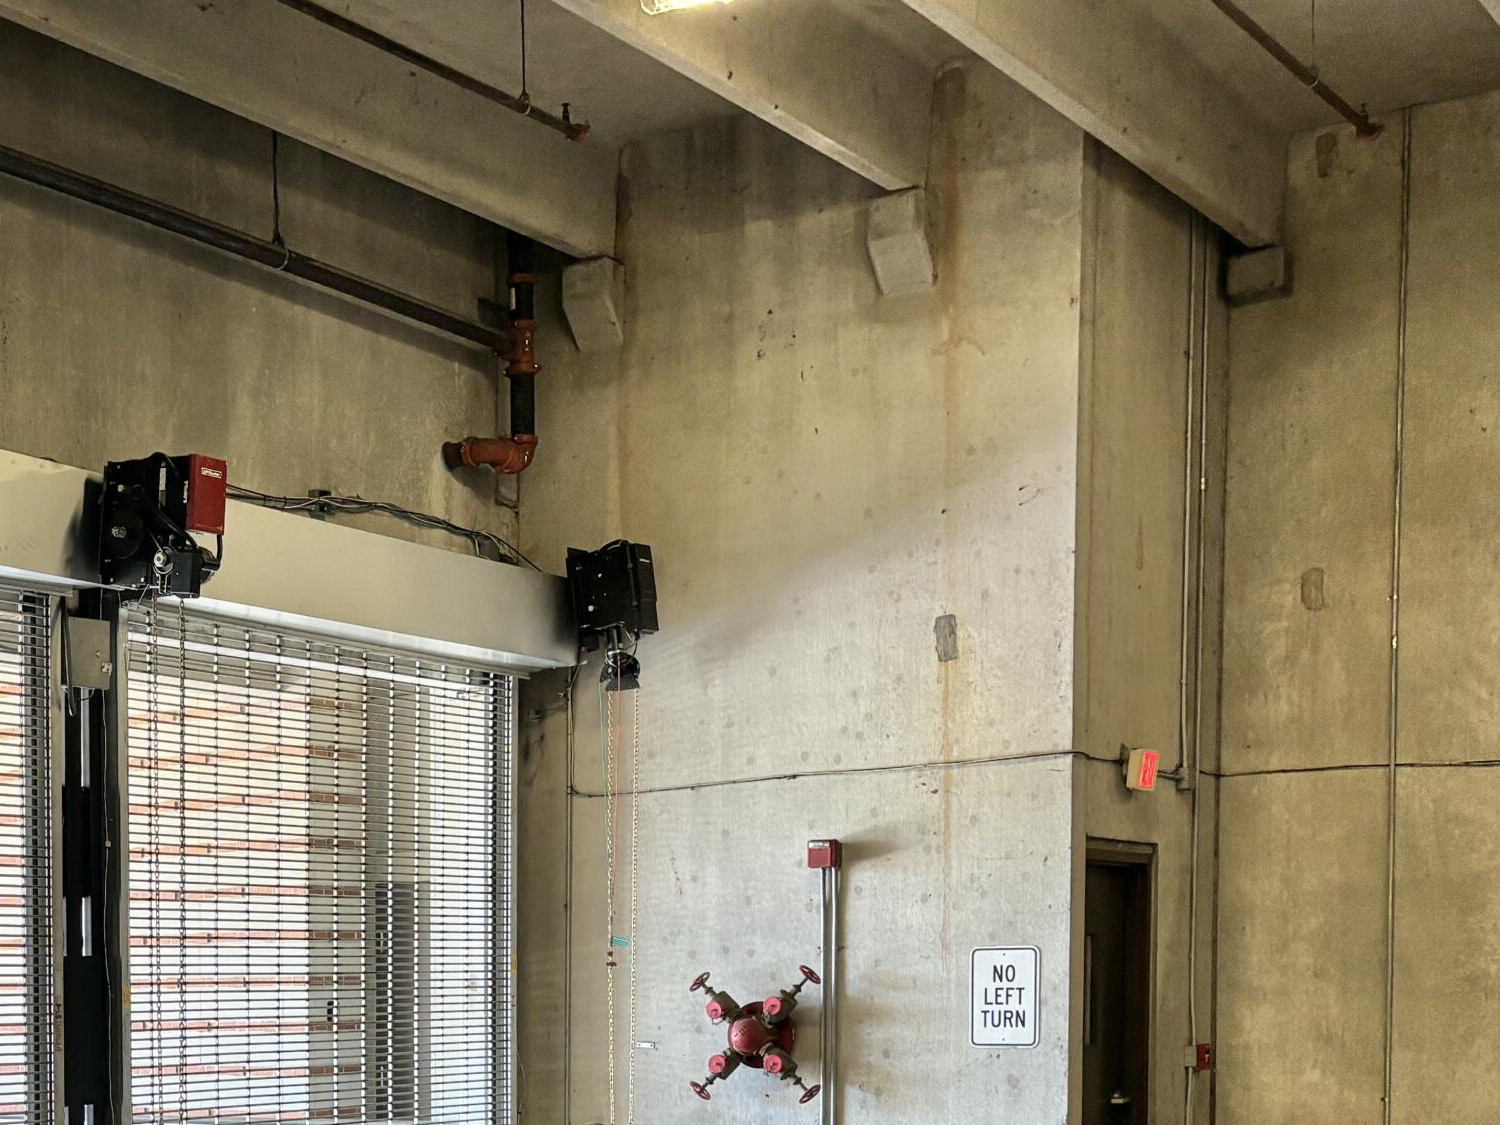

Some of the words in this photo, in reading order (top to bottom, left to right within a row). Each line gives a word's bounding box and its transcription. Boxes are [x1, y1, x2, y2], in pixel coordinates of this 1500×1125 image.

[993, 964, 1016, 983] NO
[984, 987, 1025, 1005] LEFT
[981, 1010, 1026, 1028] TURN
